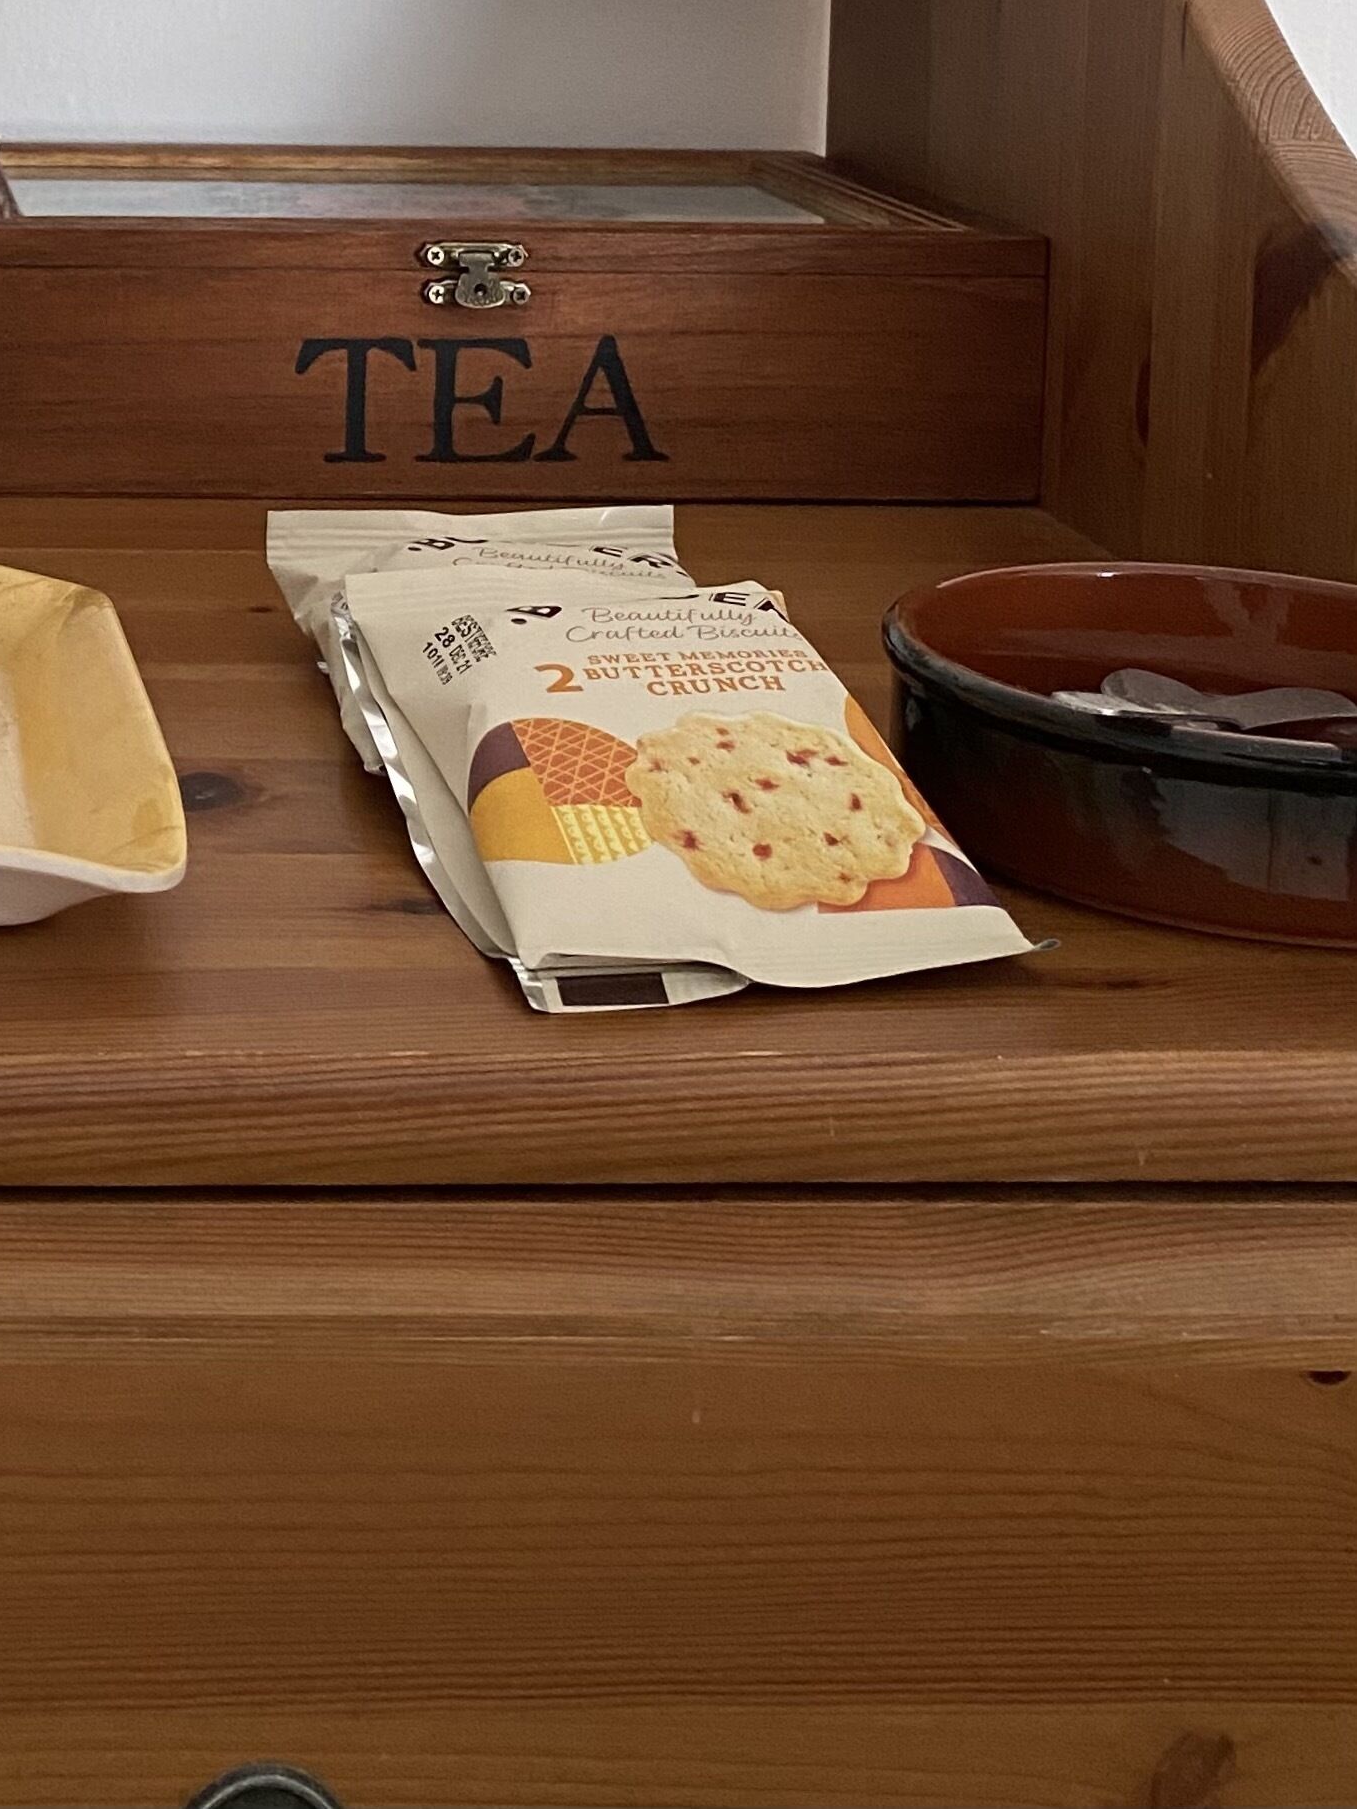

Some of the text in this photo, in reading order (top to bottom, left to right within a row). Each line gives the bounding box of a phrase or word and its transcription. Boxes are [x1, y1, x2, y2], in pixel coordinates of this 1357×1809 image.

[294, 334, 670, 463] TEA
[581, 605, 755, 625] Beautifully
[434, 626, 456, 648] 28
[565, 624, 685, 643] Crafted
[586, 648, 809, 665] SWEET MEMORIES
[533, 663, 584, 694] 2
[582, 660, 829, 681] BUTTERSCOTCH
[646, 674, 787, 697] CRUNCH
